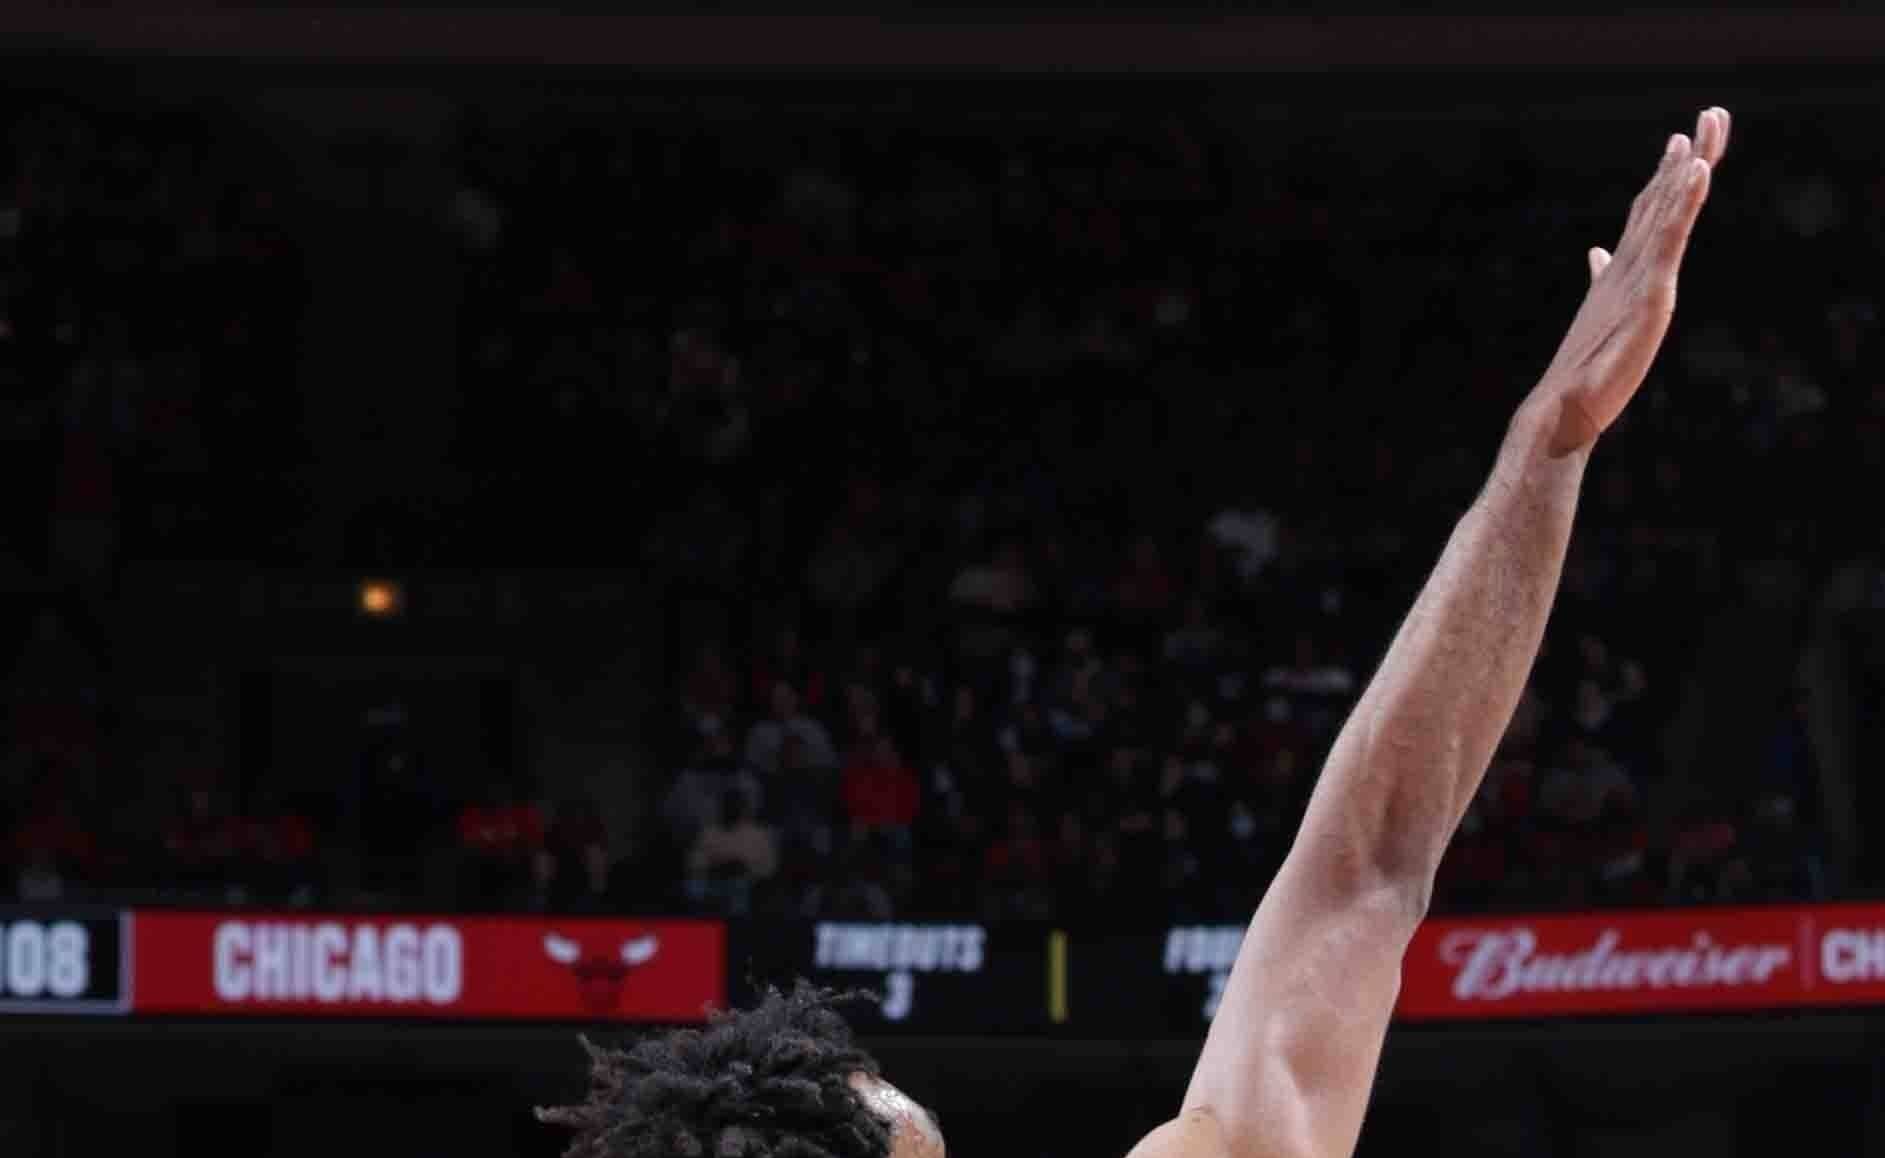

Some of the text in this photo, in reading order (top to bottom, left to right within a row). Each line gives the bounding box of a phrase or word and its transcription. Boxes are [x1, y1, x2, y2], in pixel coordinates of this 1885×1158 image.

[0, 920, 91, 998] 08
[212, 920, 464, 1004] CHICAGO
[815, 922, 987, 971] TIMEOUTS
[1438, 926, 1791, 1000] Budweiser
